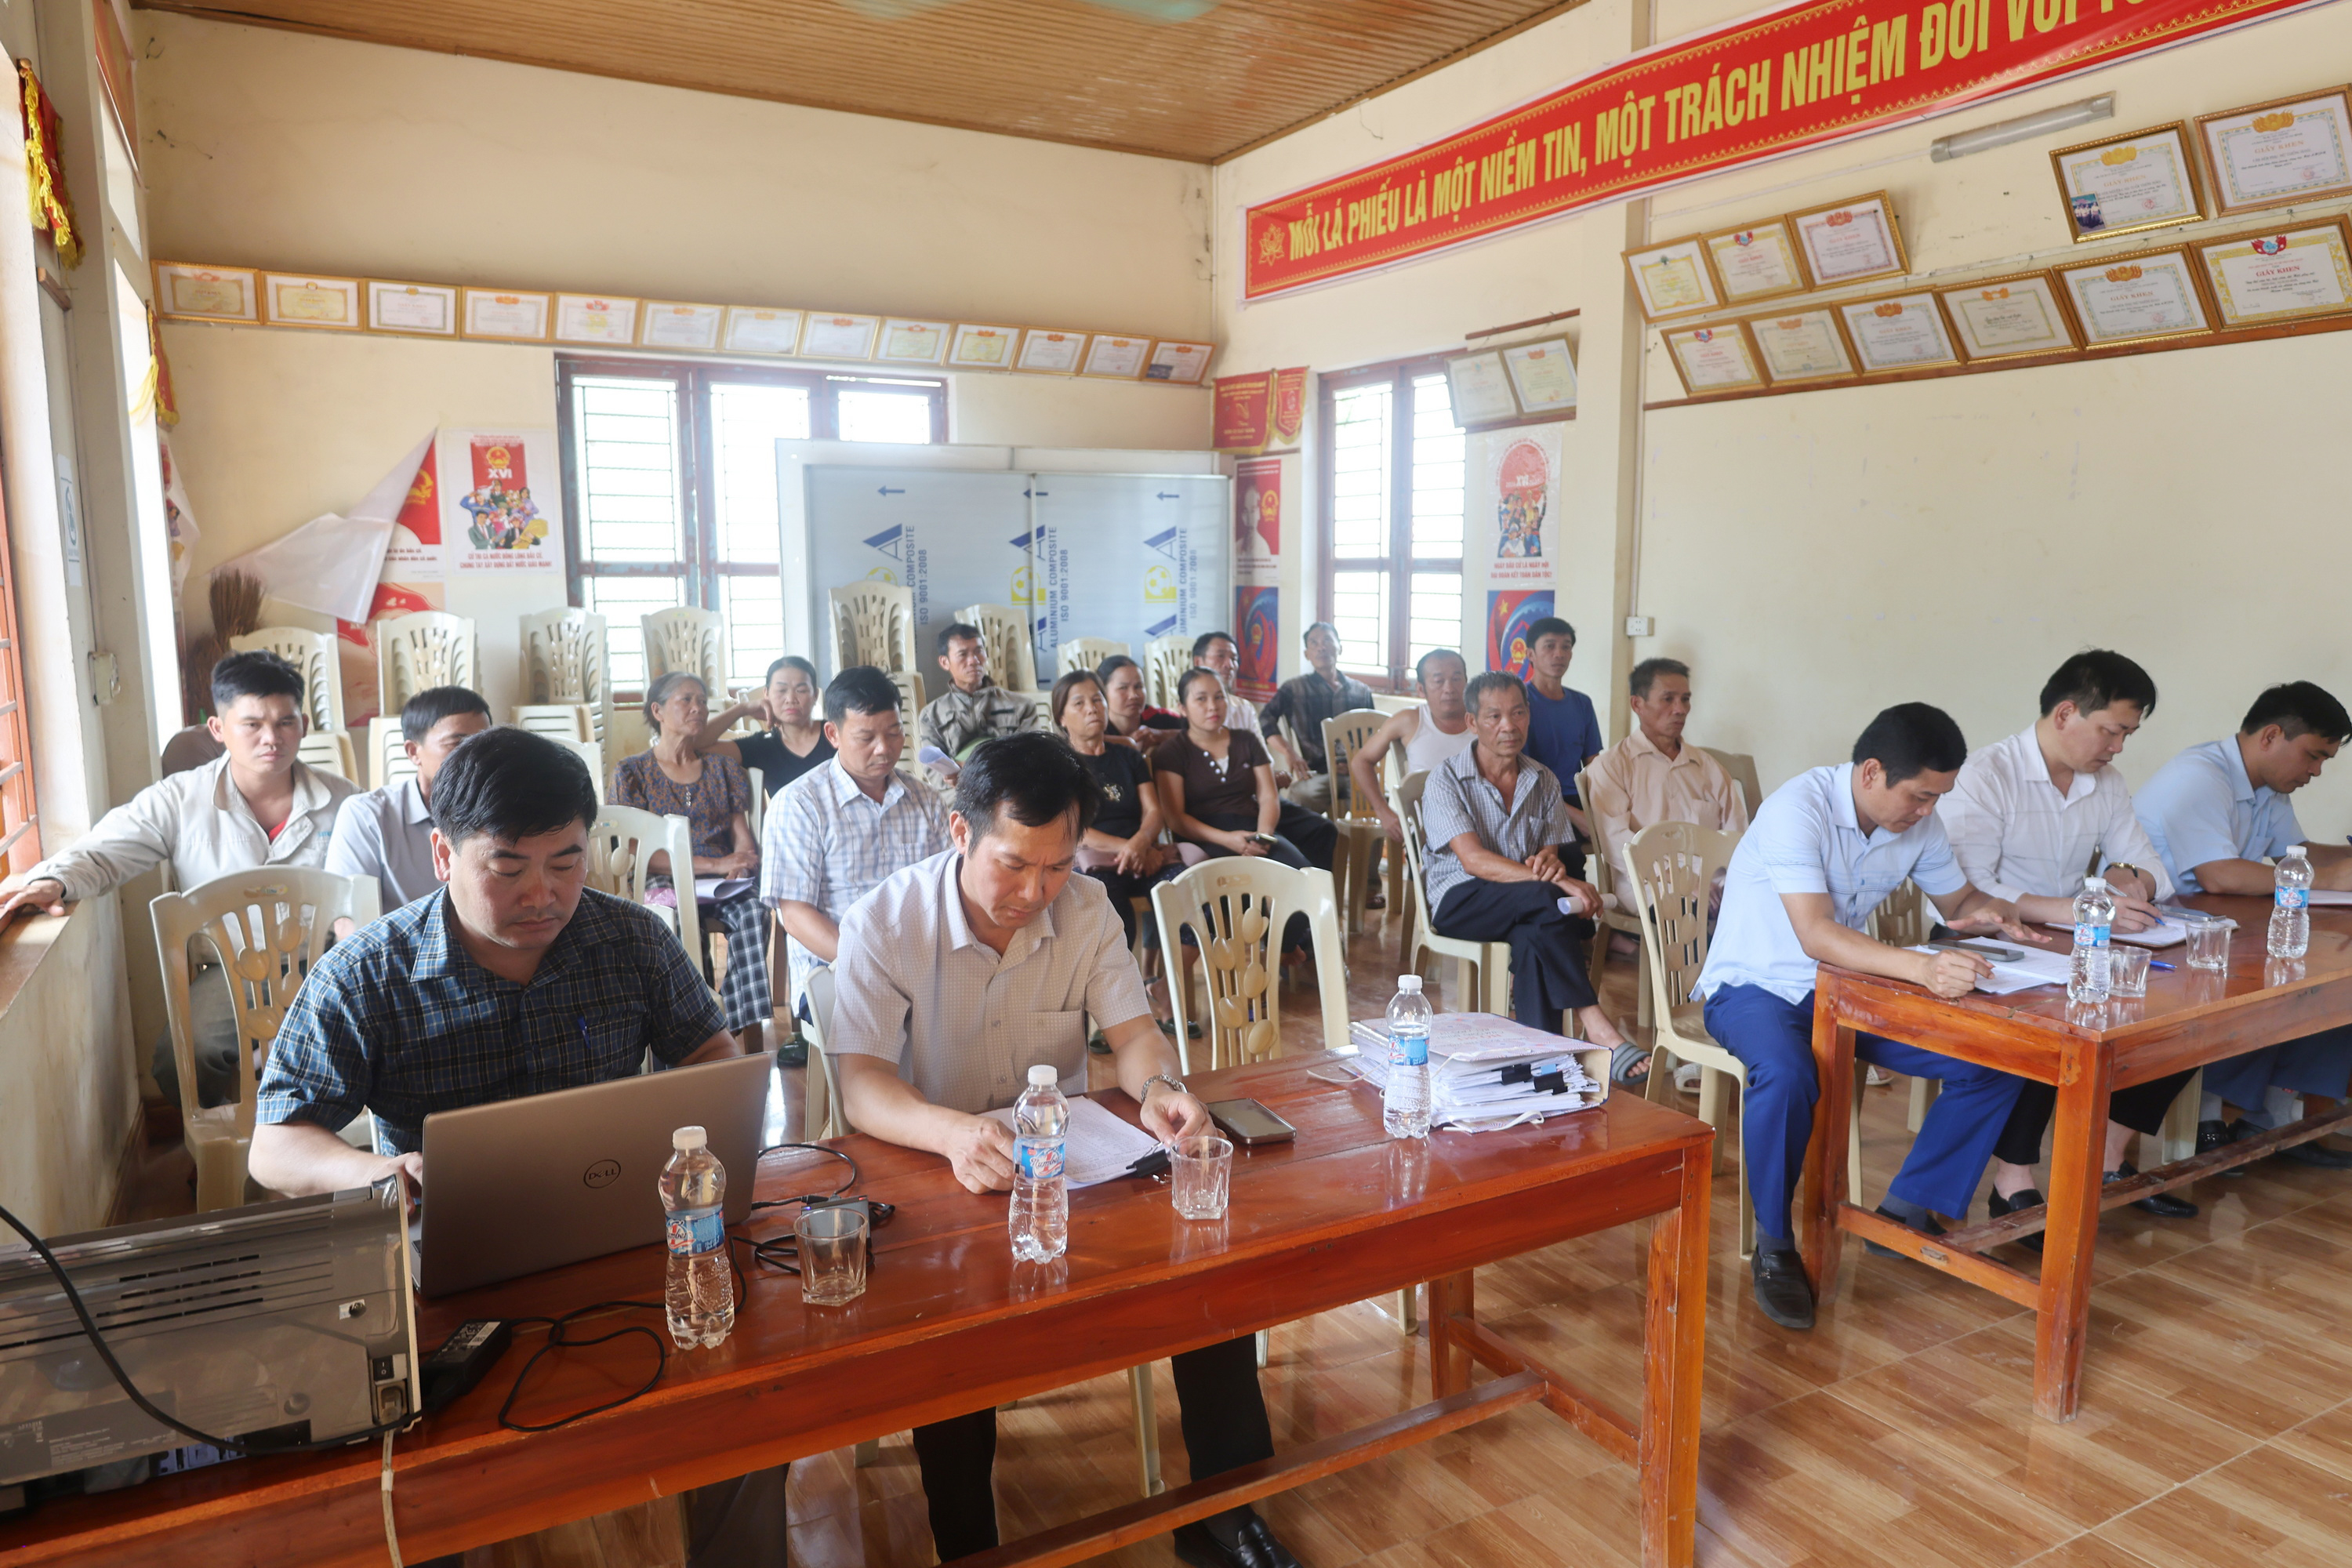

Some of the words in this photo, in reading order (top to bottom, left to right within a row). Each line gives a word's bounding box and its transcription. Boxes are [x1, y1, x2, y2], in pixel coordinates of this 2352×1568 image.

[1288, 202, 1320, 260] MỖI
[1322, 198, 1344, 251] LÁ
[1347, 177, 1400, 244] PHIẾU
[1404, 170, 1427, 227] LÀ
[1432, 156, 1476, 223] MỘT
[1479, 132, 1537, 202] NIỀM
[1543, 122, 1588, 182] TIN,
[1595, 90, 1656, 168] MỘT
[1664, 62, 1771, 144] TRÁCH
[1780, 15, 1907, 111] NHIỆM
[2256, 268, 2275, 278] GIẤY
[2277, 265, 2300, 274] KHEN
[488, 468, 513, 479] XVI
[906, 525, 916, 587] COMPOSITE
[918, 549, 928, 604] 9001:2008
[1048, 526, 1058, 586] COMPOSITE
[1060, 549, 1069, 601] 9001:2008
[1179, 528, 1188, 584] COMPOSITE
[920, 608, 929, 625] ISO
[1049, 590, 1058, 649] ALUMINIUM
[1061, 604, 1069, 622] ISO
[1179, 589, 1188, 637] UMINIUM
[589, 1168, 617, 1180] DELL
